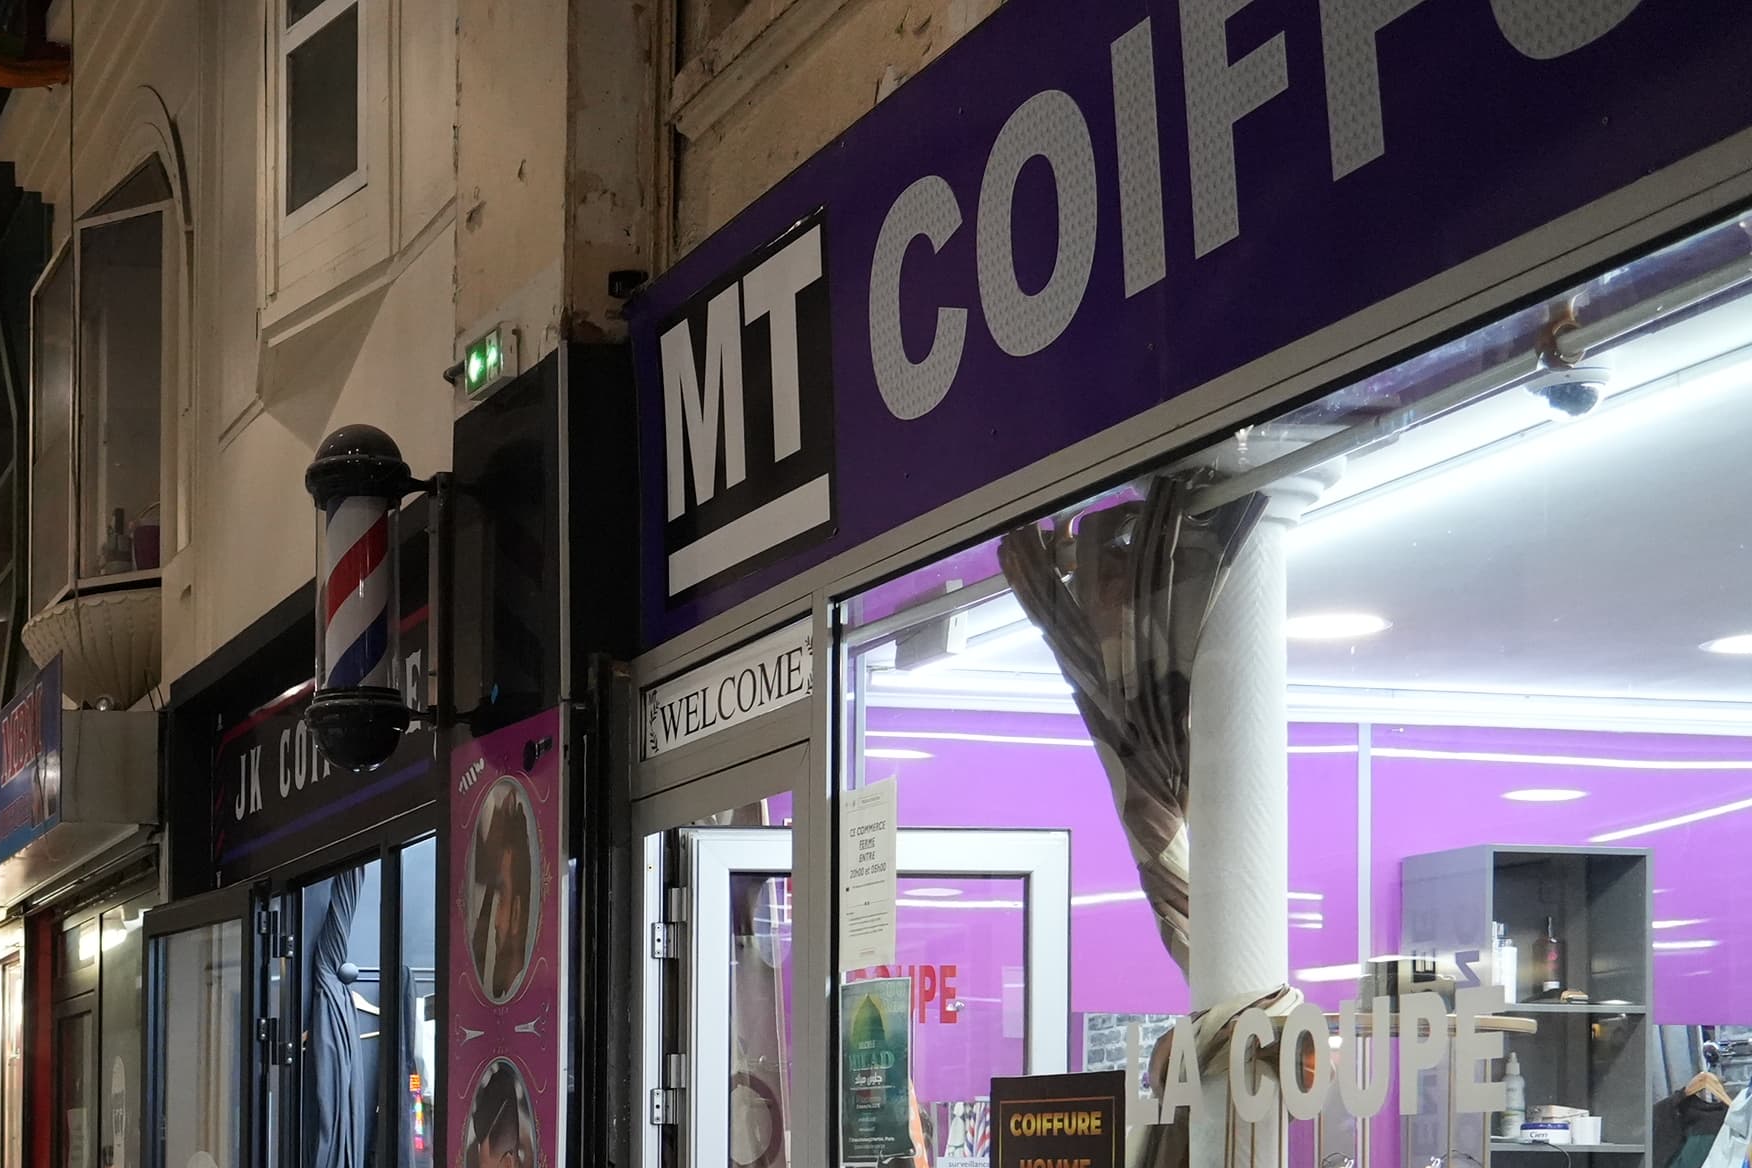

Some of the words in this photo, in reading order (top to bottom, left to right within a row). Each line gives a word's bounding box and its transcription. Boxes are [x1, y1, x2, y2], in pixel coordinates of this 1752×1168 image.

[659, 224, 826, 520] MT
[659, 646, 804, 743] WELCOME
[234, 743, 263, 821] JK
[857, 820, 886, 836] COMMERCE
[859, 851, 875, 863] ENTRE
[1127, 1017, 1202, 1125] LA
[1230, 984, 1506, 1123] COUPE
[1010, 1110, 1102, 1138] COIFFURE
